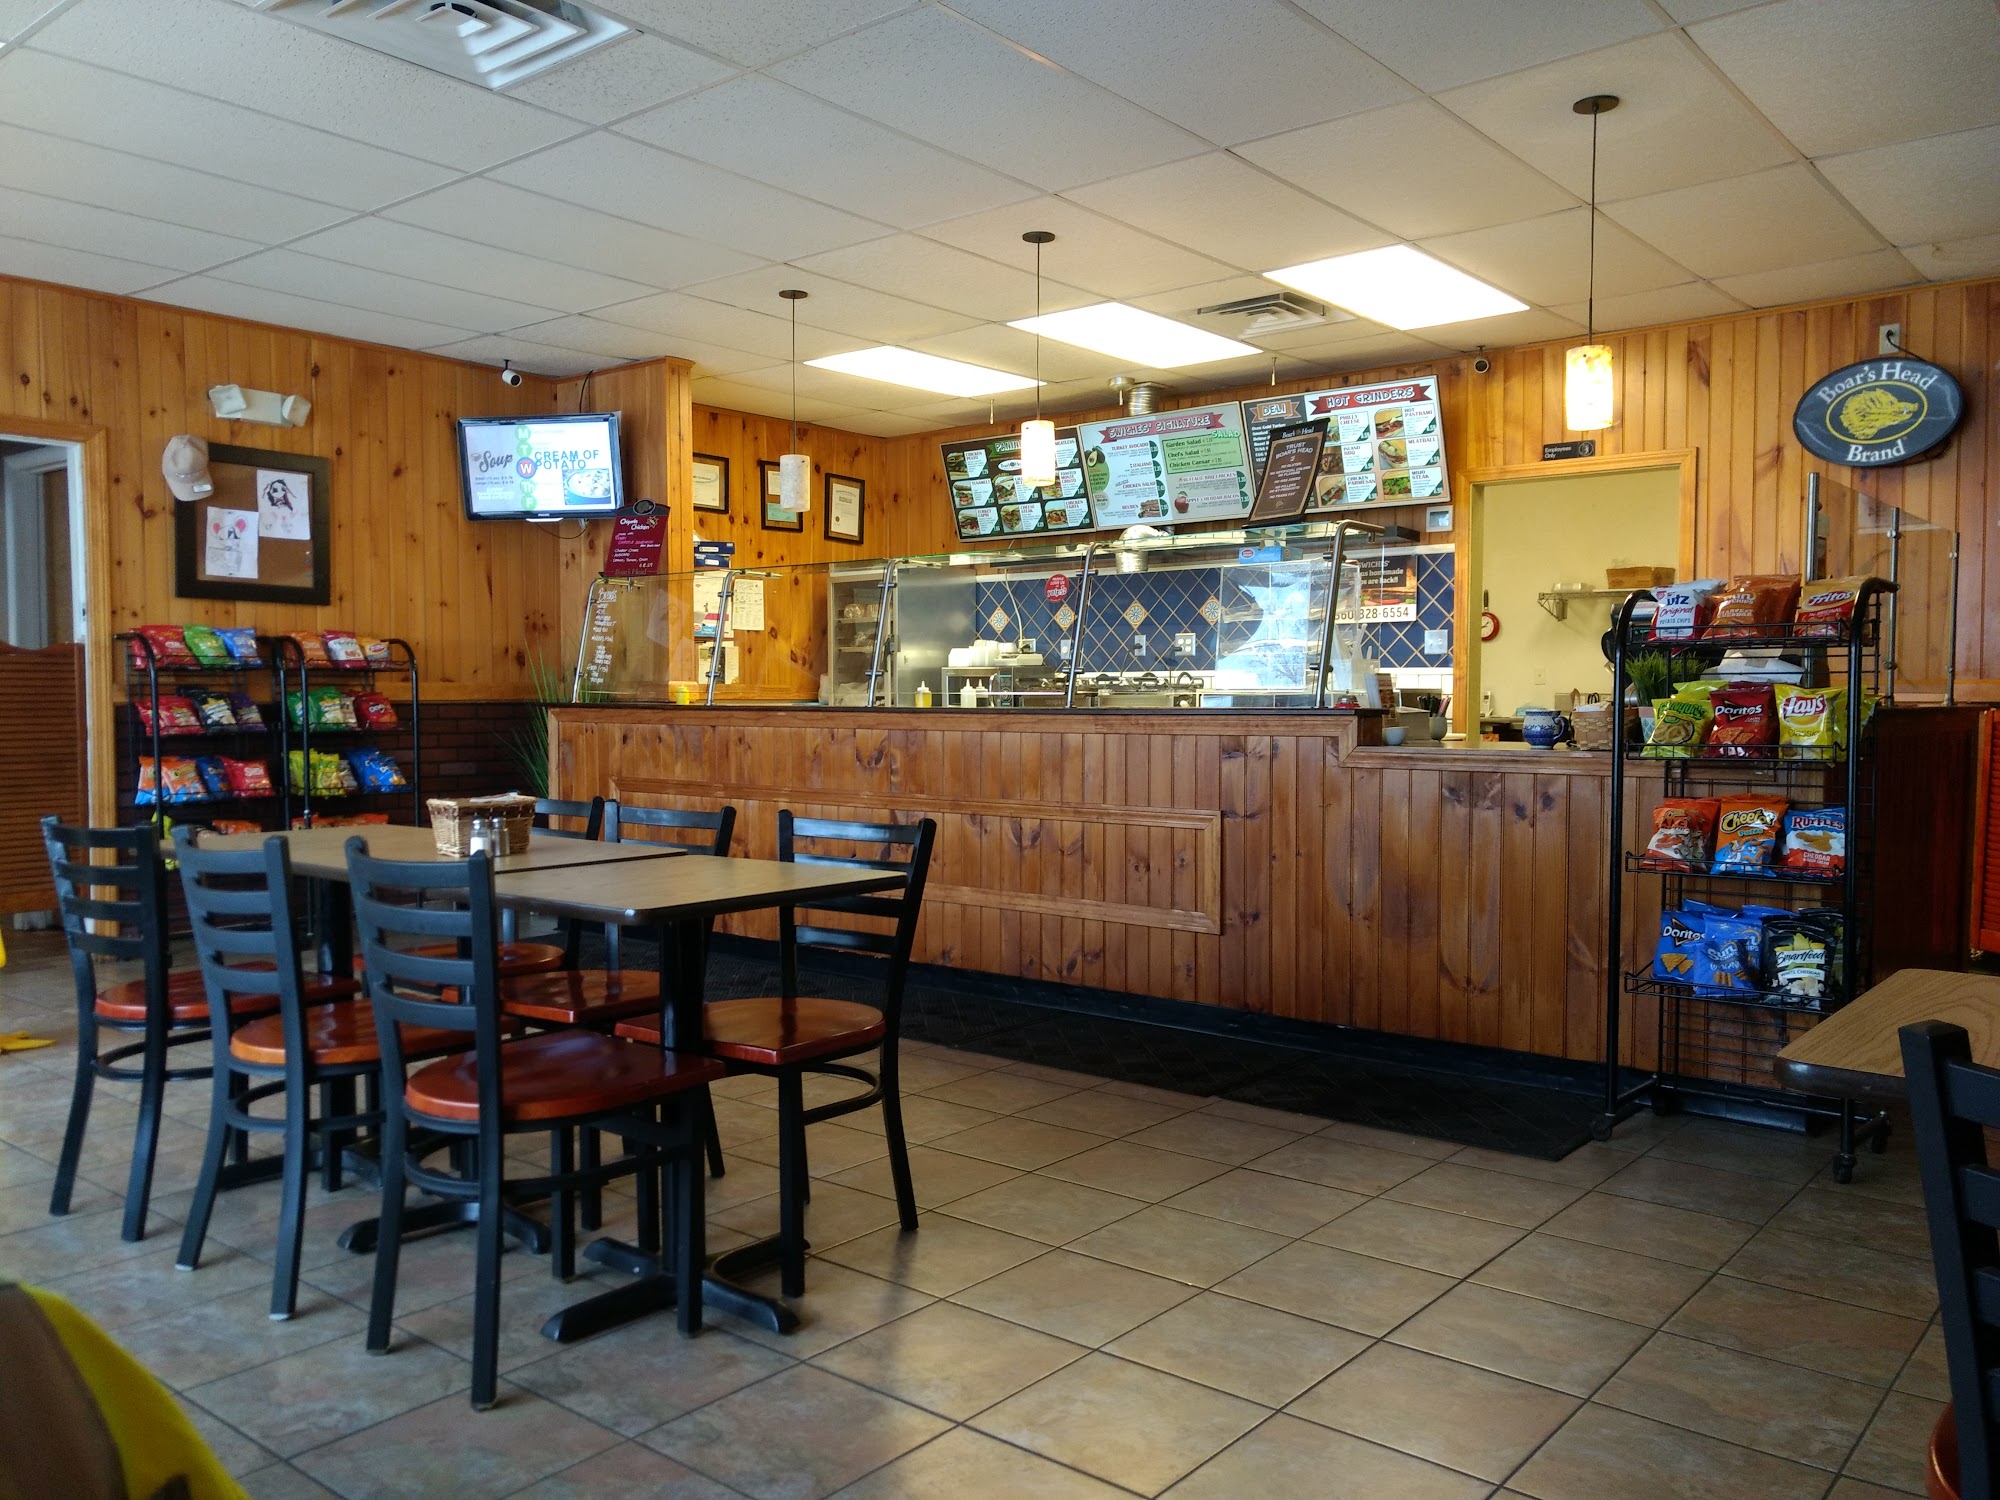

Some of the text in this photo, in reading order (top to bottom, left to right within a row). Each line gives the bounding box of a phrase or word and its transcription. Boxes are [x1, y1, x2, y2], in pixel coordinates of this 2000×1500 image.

[1816, 362, 1940, 405] Boar's Head
[1327, 387, 1415, 408] HOT GRINDERS
[1262, 403, 1286, 417] DELI
[1155, 414, 1211, 432] SIGNATURE
[518, 427, 530, 440] M
[1212, 430, 1241, 439] SALAD
[1186, 438, 1202, 447] Salad
[1286, 442, 1306, 450] TRUST
[520, 445, 529, 456] T
[534, 449, 600, 462] CREAM OF
[1275, 447, 1314, 460] BOAR'S HEAD
[1544, 446, 1572, 454] Employees
[1846, 438, 1906, 463] Brand
[479, 450, 513, 473] Soup
[535, 459, 587, 471] POTATO
[1169, 460, 1190, 468] Chicken
[1191, 458, 1210, 466] Caesar
[520, 463, 533, 475] W
[1808, 590, 1854, 607] Fritos
[1659, 606, 1695, 619] Original
[1659, 617, 1691, 626] POTATO CHIPS
[1714, 704, 1763, 717] Doritos
[1788, 694, 1825, 718] Lay's
[1791, 816, 1844, 831] RUFFLES
[1803, 851, 1831, 862] CHEDDAR
[1776, 949, 1825, 967] Smartfood
